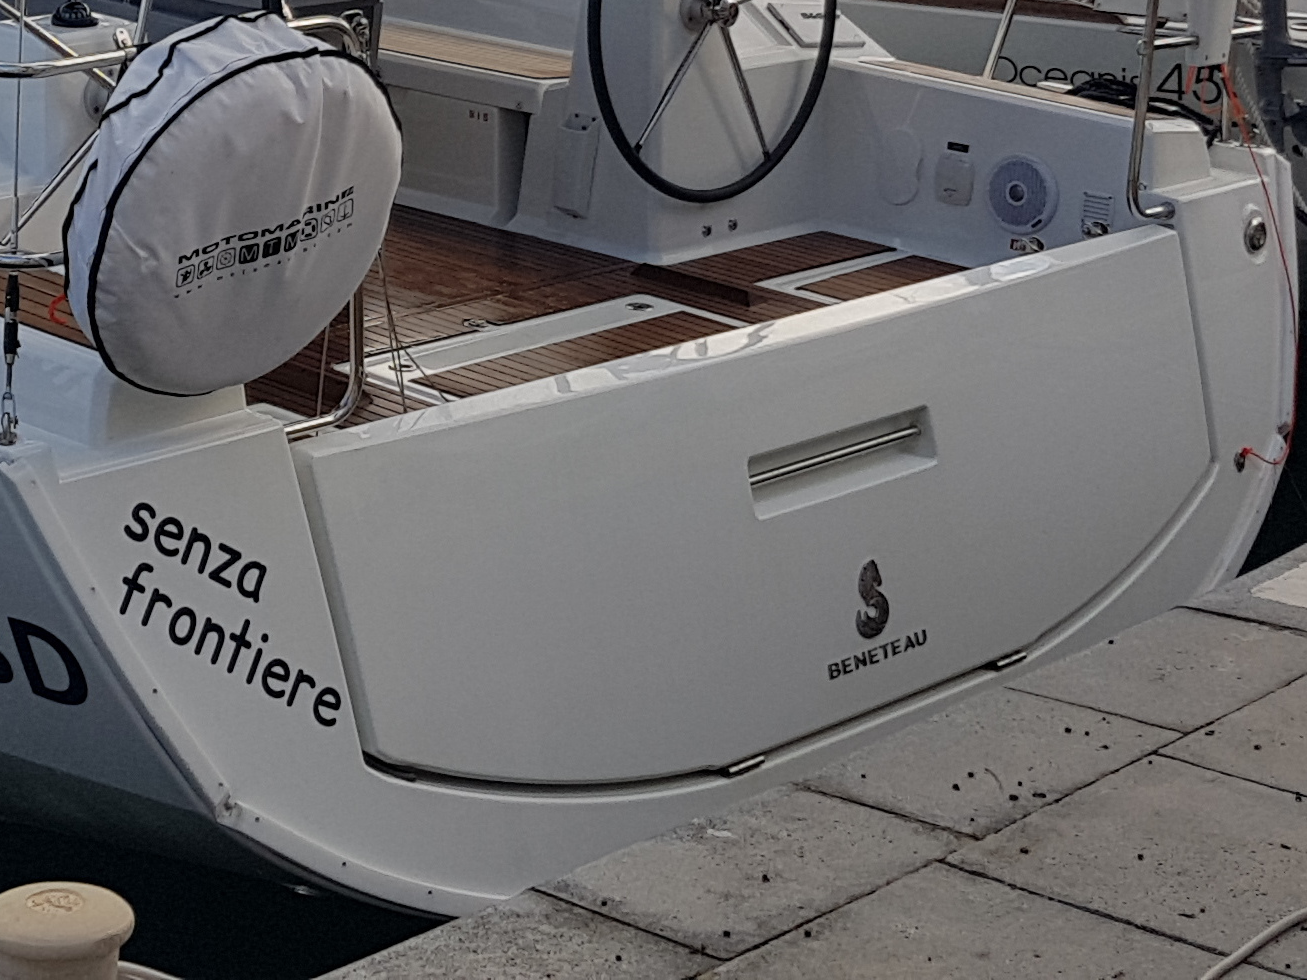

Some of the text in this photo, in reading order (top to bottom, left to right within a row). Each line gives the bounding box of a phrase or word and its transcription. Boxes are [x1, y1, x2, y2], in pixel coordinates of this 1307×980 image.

[993, 55, 1223, 105] Ocea 45
[178, 186, 354, 264] MOTOMARINE
[123, 501, 267, 604] senza
[119, 562, 342, 728] frontiere
[827, 629, 928, 681] BENETEAU
